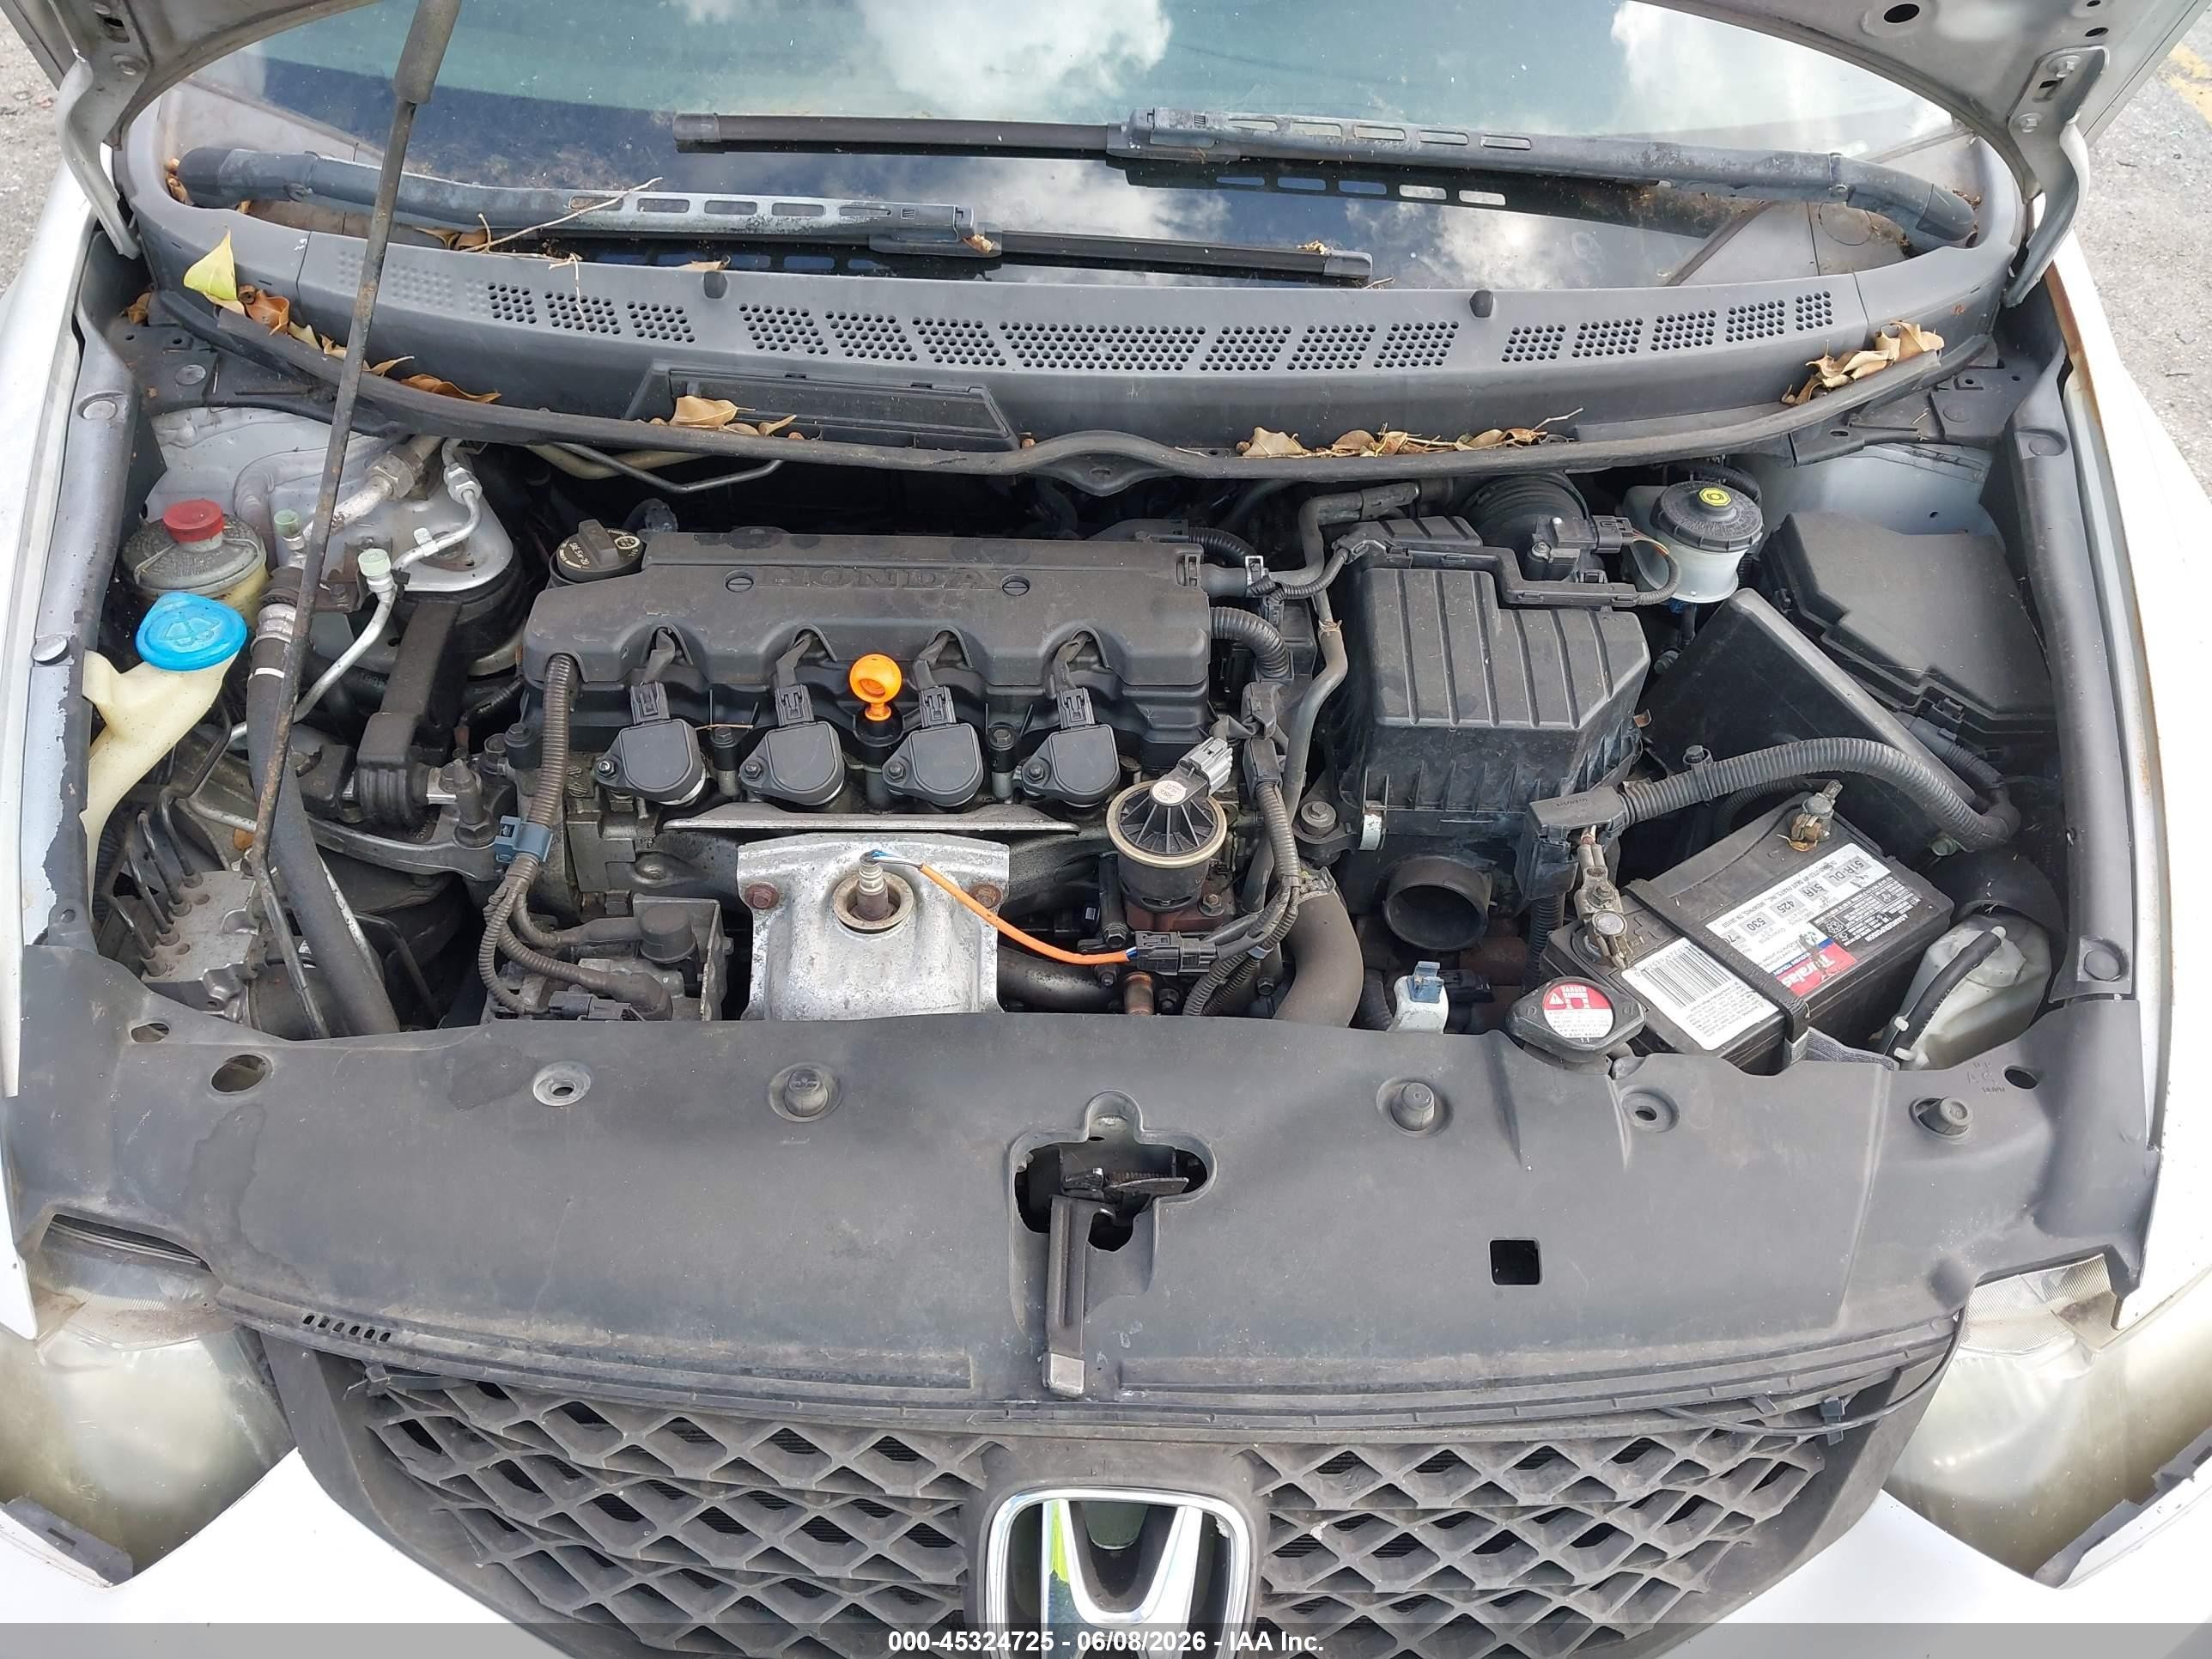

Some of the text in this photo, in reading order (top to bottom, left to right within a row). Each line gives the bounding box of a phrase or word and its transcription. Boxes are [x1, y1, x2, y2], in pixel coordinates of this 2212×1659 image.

[757, 567, 999, 591] HONDA
[1828, 860, 1864, 883] 51R-DL
[1801, 883, 1824, 898] 51R
[1776, 899, 1796, 913] 425
[1745, 916, 1766, 931] 530
